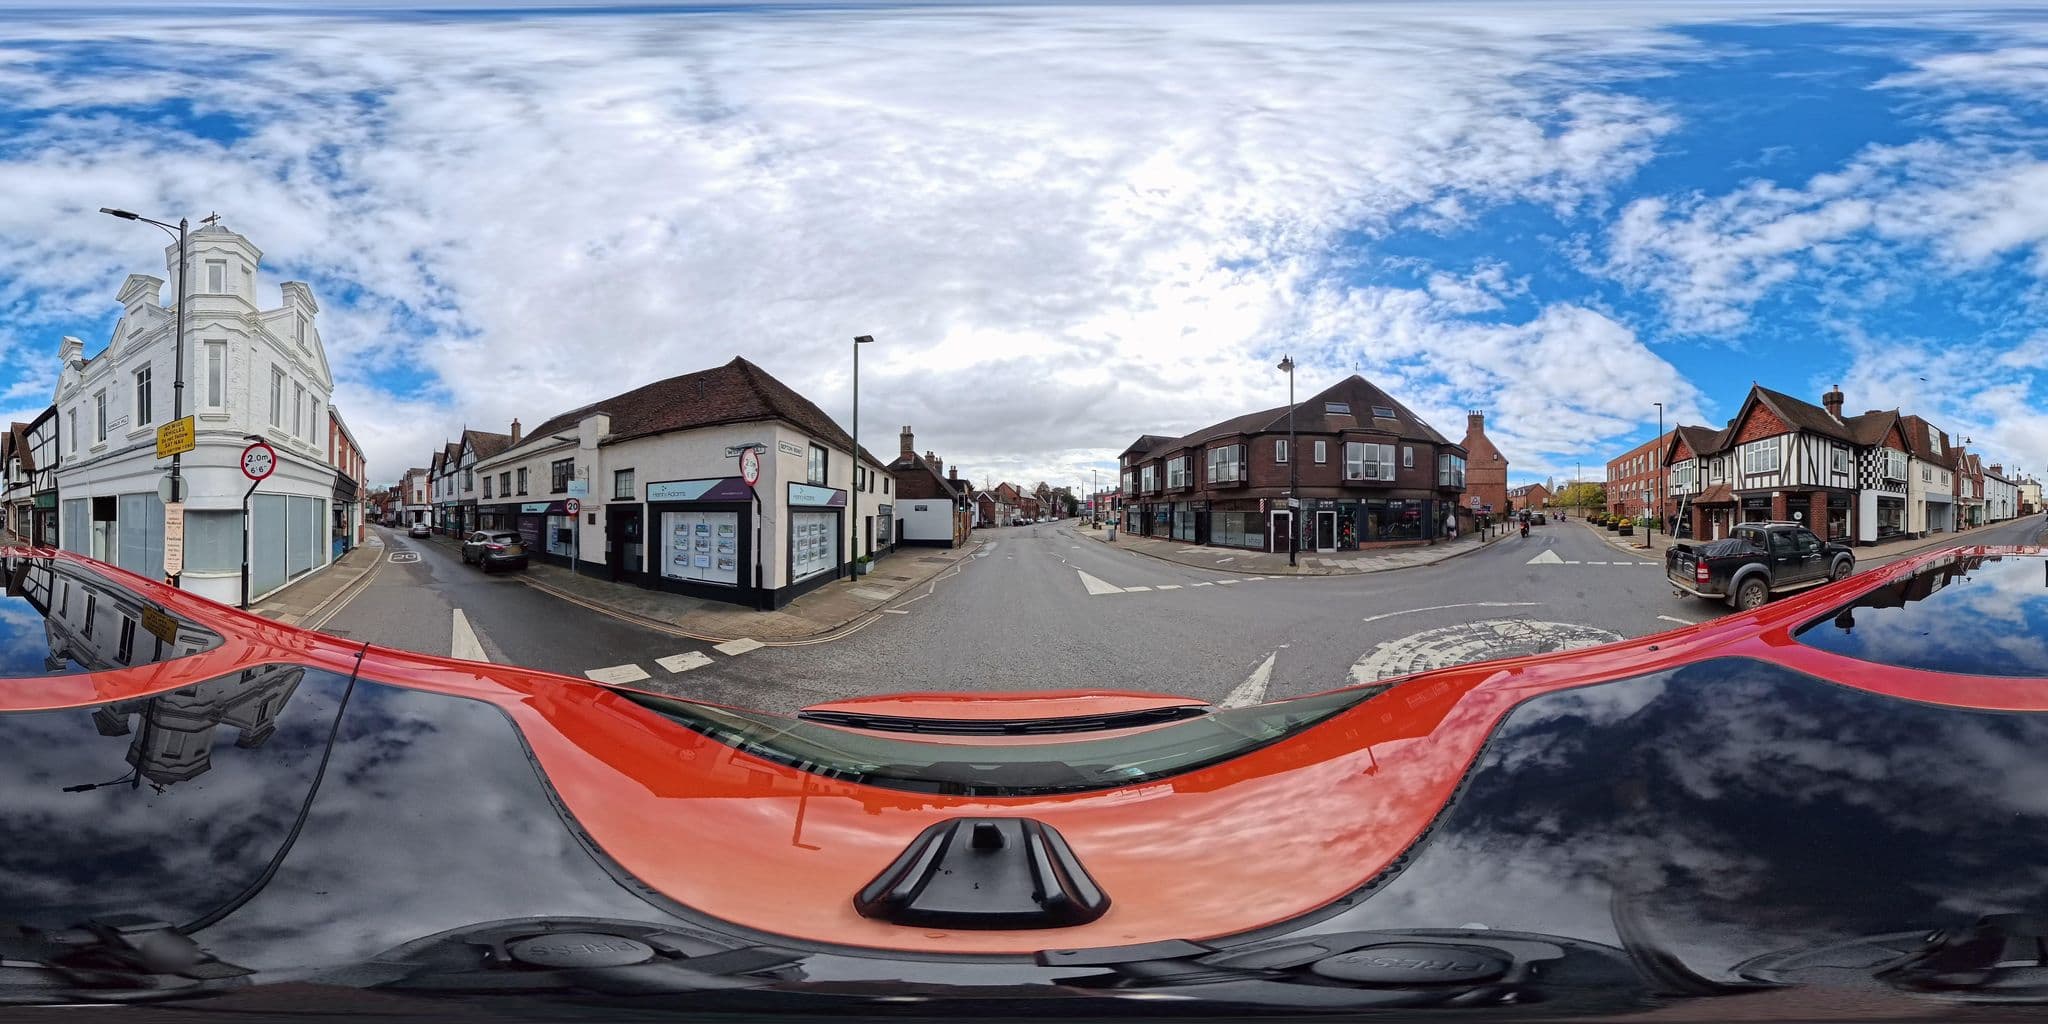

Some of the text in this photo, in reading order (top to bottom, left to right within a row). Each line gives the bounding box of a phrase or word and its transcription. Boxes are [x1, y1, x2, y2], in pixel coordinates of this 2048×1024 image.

[163, 426, 185, 437] VEHICLES
[247, 454, 268, 463] 2.0m
[567, 502, 578, 511] 20
[1336, 955, 1486, 972] PRESS
